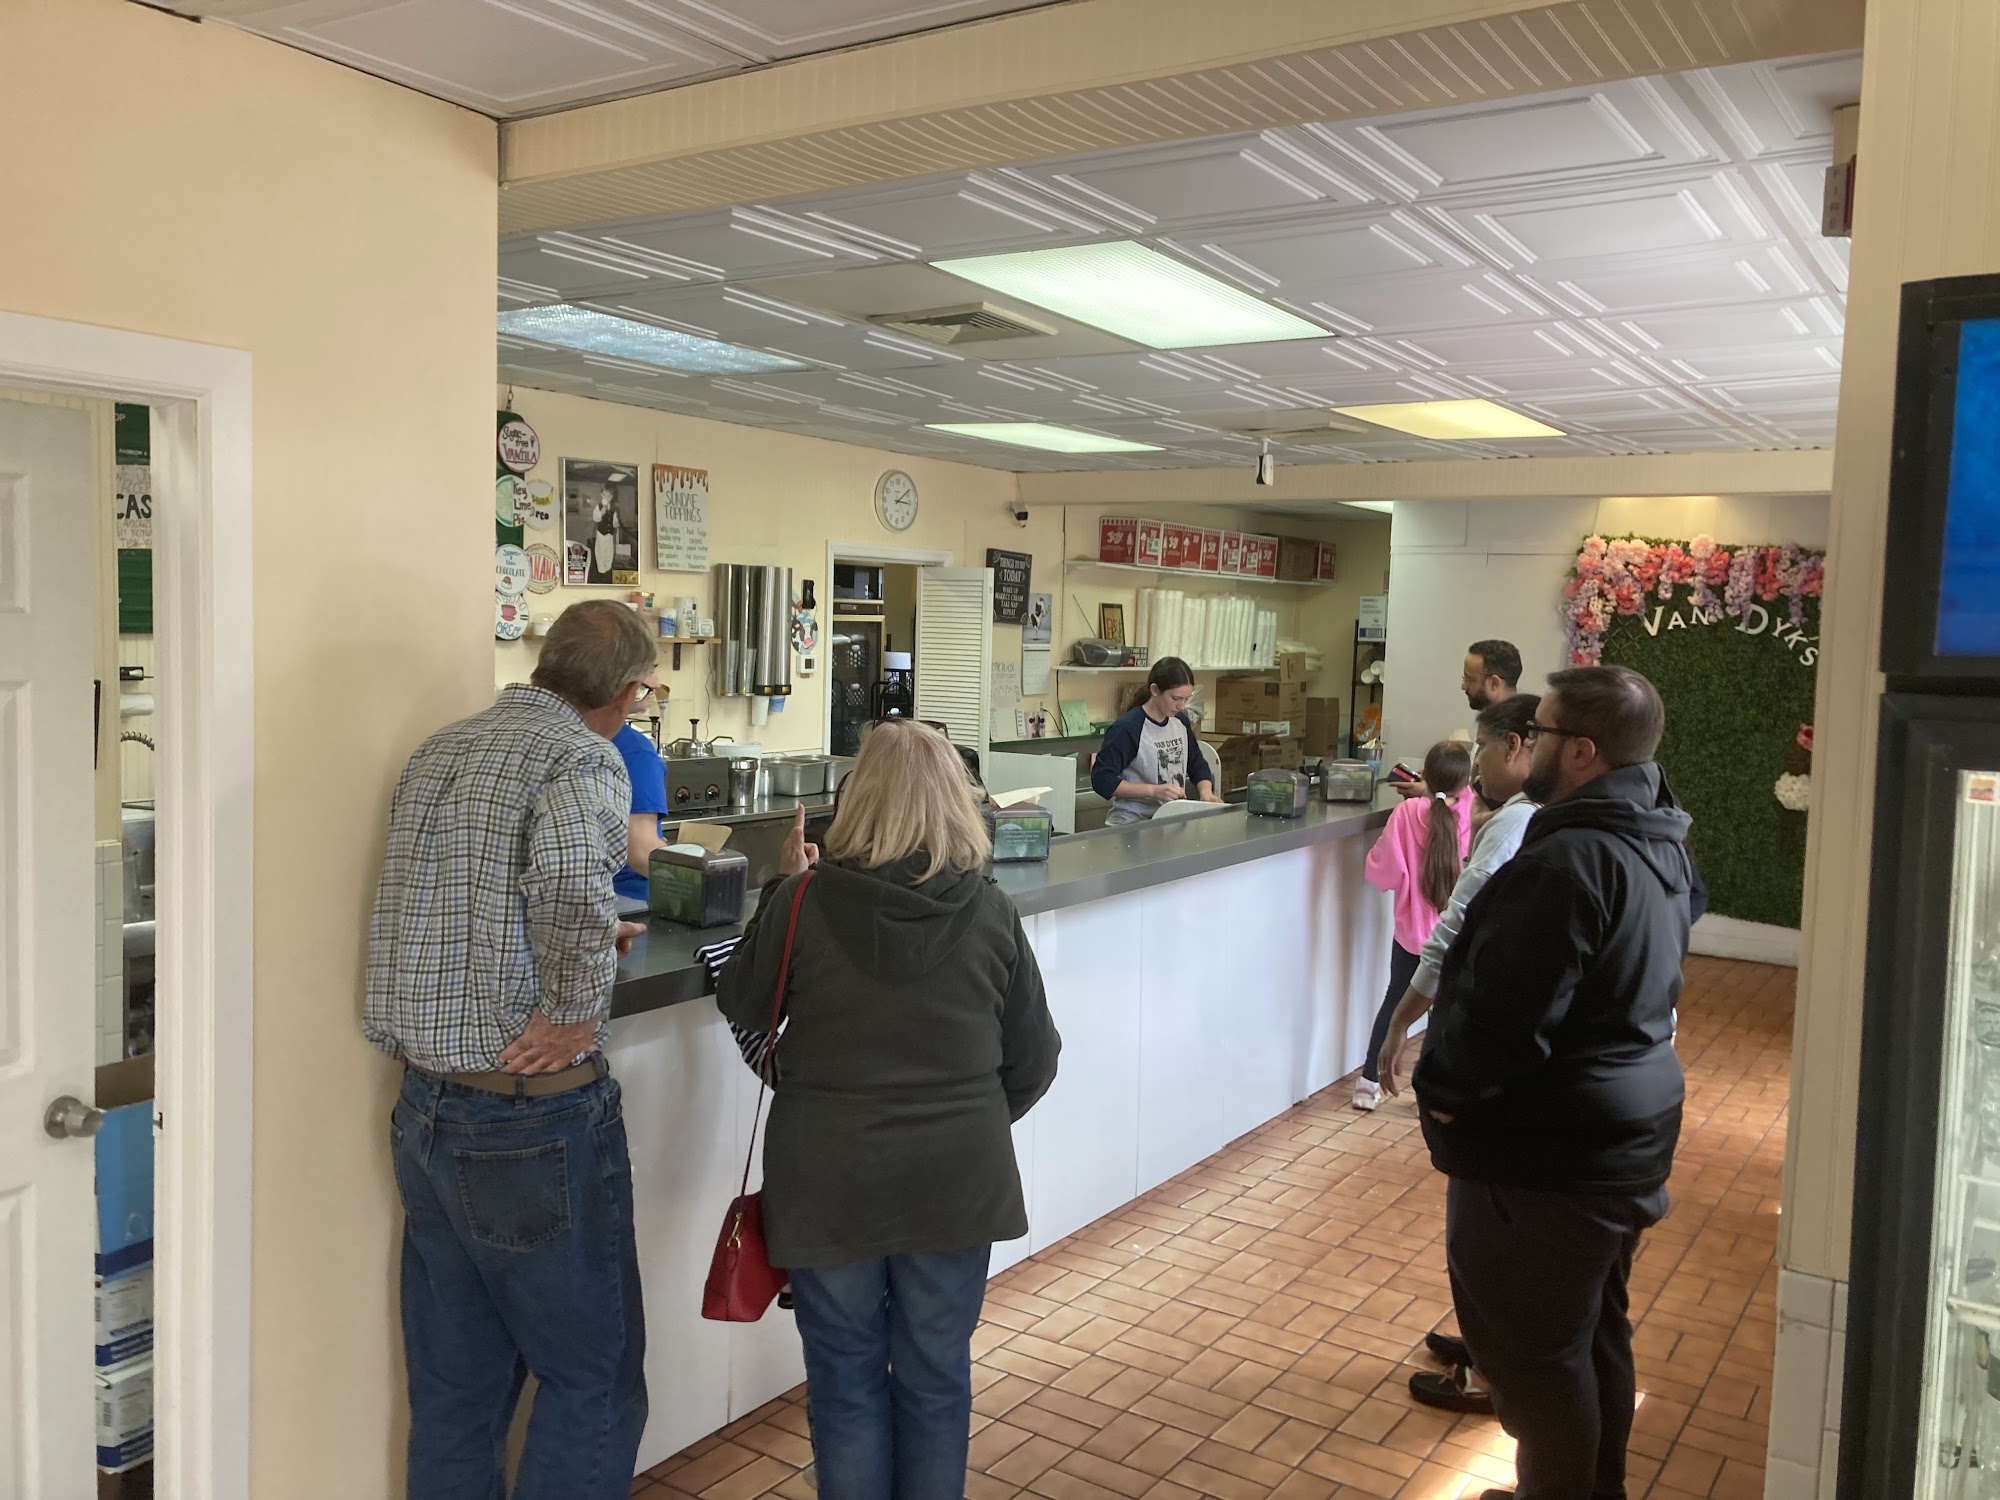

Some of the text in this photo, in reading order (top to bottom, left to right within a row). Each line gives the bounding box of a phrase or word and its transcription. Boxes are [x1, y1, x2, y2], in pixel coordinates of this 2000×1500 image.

[502, 442, 538, 464] VANILLA
[513, 480, 527, 499] Key
[514, 498, 532, 511] Lime
[665, 490, 698, 508] SUNDAE
[663, 504, 702, 522] TOPPINGS
[1000, 558, 1026, 570] THINGS TO DO
[496, 566, 526, 578] CHOCOLATE
[1004, 569, 1022, 582] TODAY
[1010, 594, 1024, 602] CREAM
[1002, 608, 1016, 616] REPEAT
[1643, 605, 1710, 637] VAN
[1154, 741, 1166, 749] VAN
